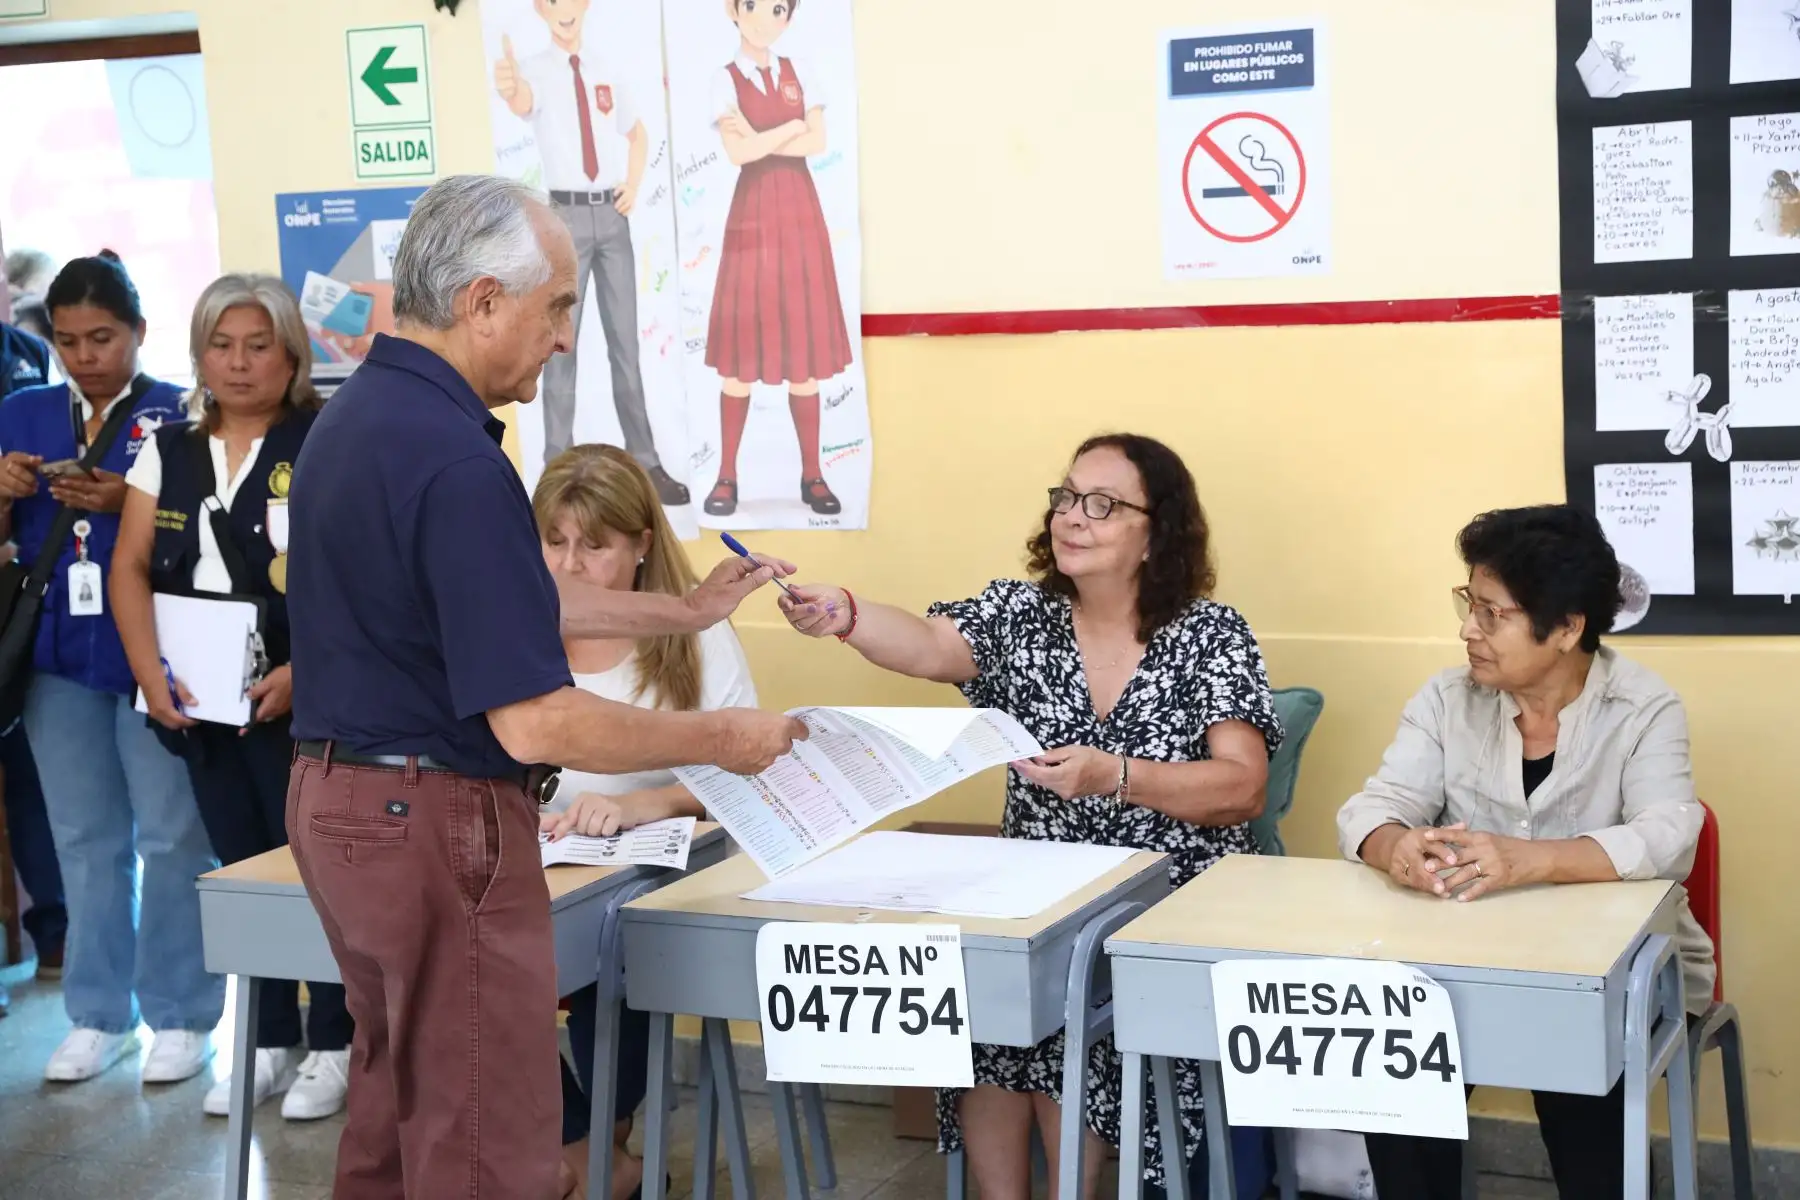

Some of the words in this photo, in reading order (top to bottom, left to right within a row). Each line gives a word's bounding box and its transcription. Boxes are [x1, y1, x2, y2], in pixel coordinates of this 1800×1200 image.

[1194, 43, 1253, 58] PROHIBIDO
[1255, 40, 1293, 53] FUMAR
[1184, 61, 1199, 72] EN
[1200, 57, 1249, 71] LUGARES
[1250, 53, 1304, 68] PÚBLICOS
[1212, 71, 1249, 83] COMO
[1250, 69, 1275, 81] ESTE
[361, 140, 429, 164] SALIDA
[1292, 255, 1322, 264] ONPE
[784, 944, 889, 976] MESA
[899, 946, 938, 976] Nº
[768, 984, 964, 1035] 047754
[1247, 982, 1372, 1016] MESA
[1383, 984, 1427, 1017] Nº
[1228, 1024, 1456, 1083] 047754
